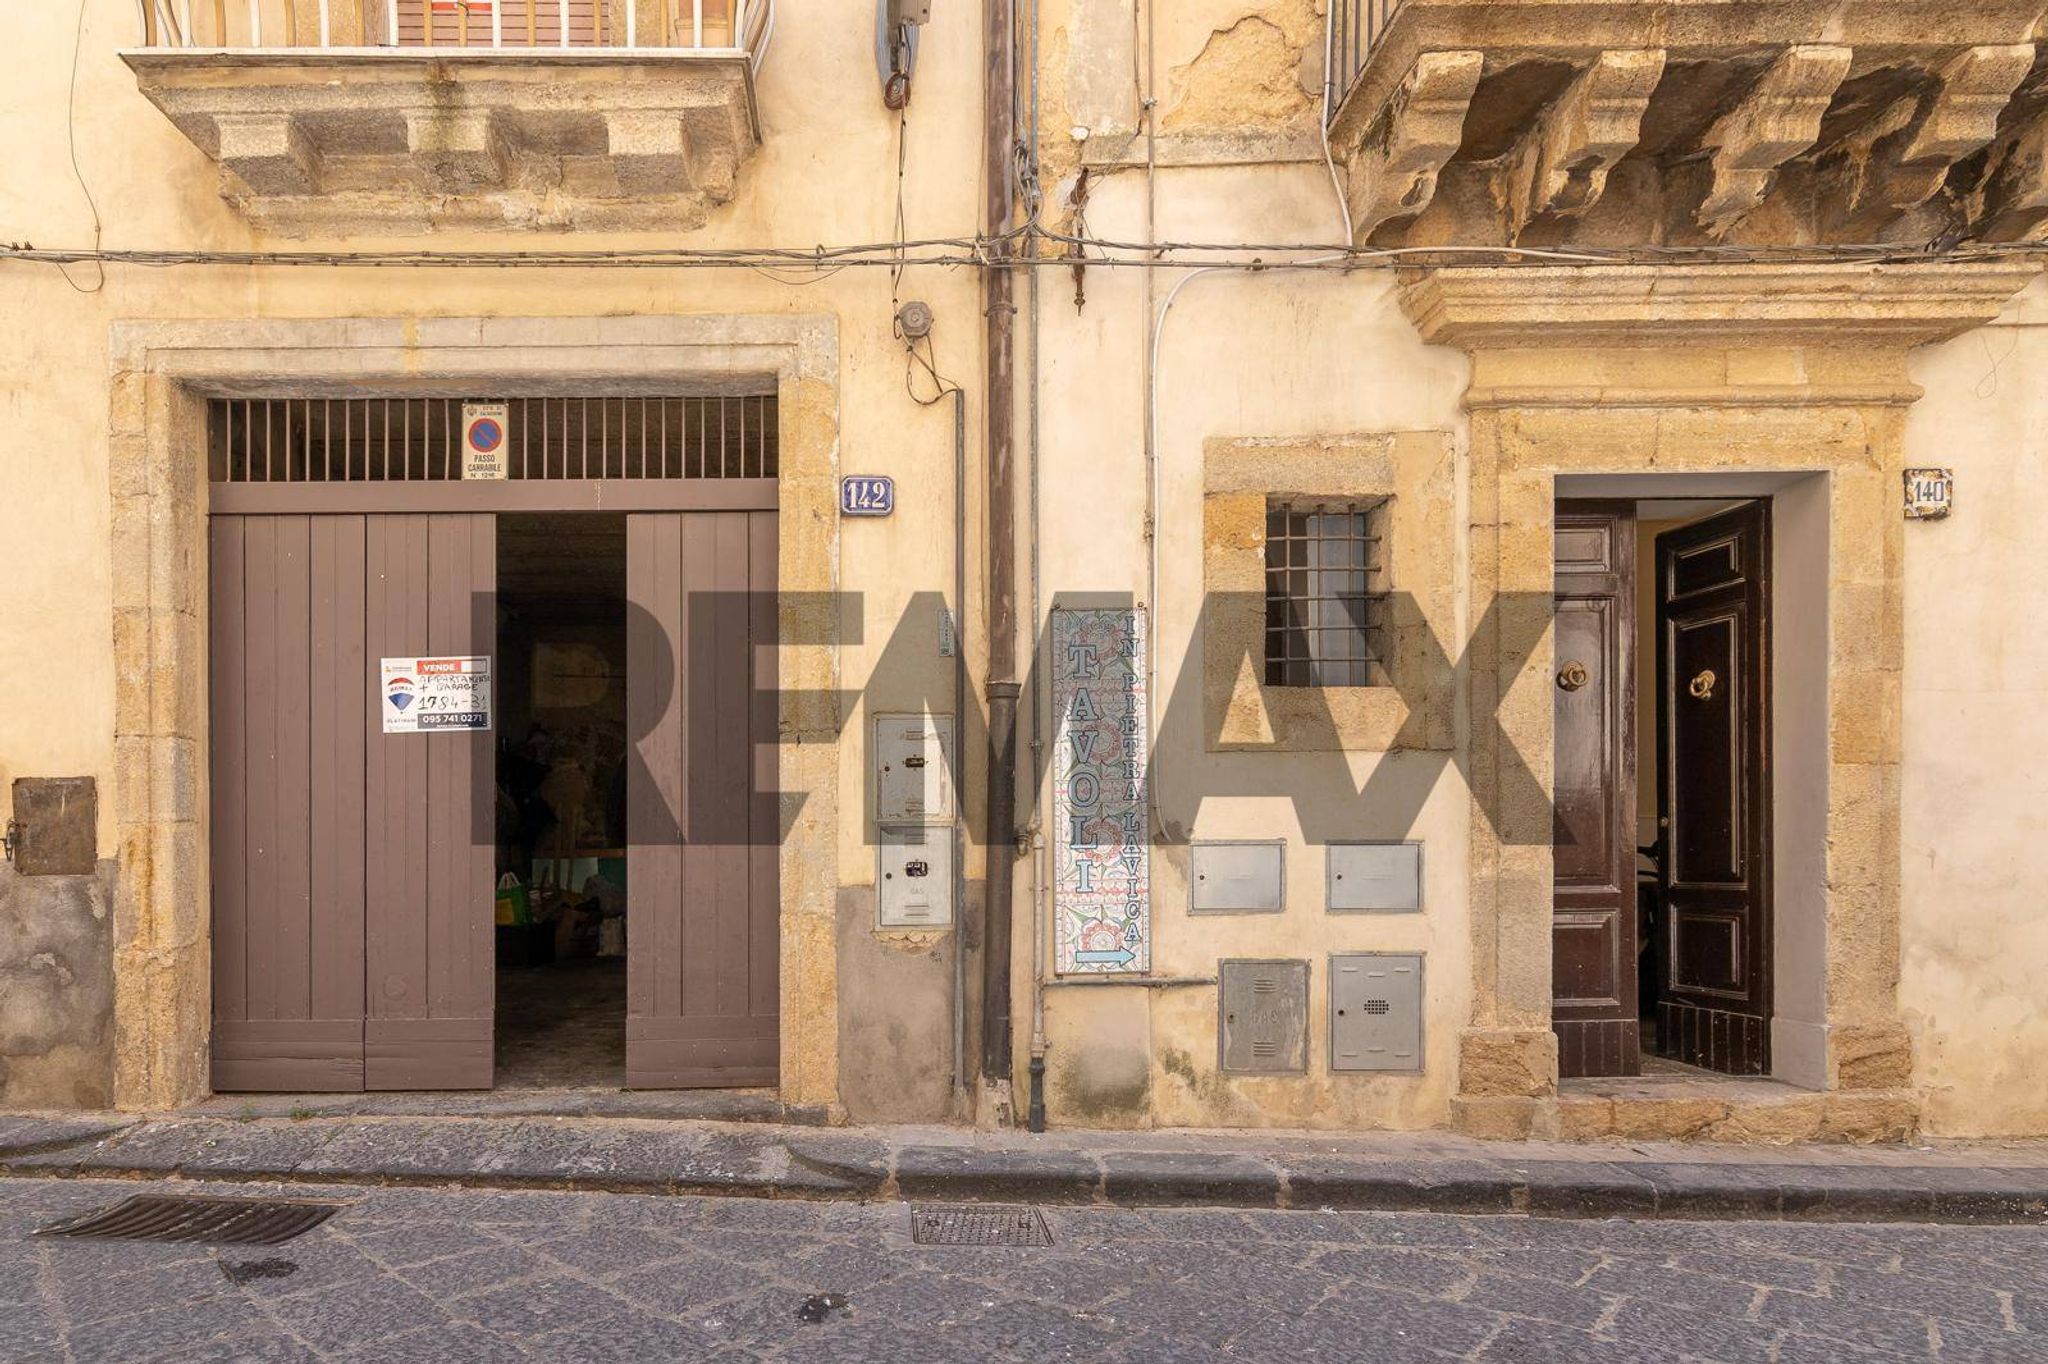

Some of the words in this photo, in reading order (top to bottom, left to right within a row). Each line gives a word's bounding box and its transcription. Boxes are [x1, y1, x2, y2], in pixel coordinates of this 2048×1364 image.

[467, 463, 502, 472] CARRABILE
[473, 454, 496, 463] PASSO
[847, 481, 886, 509] 142
[1914, 480, 1945, 502] 140
[1121, 615, 1140, 658] IN
[423, 663, 456, 672] VENDE
[422, 715, 442, 723] 095
[443, 714, 459, 723] 741
[460, 714, 483, 722] 0271
[1122, 673, 1141, 801] PIETRA
[1067, 644, 1101, 893] TAVOLI
[1123, 812, 1142, 942] LAVICA
